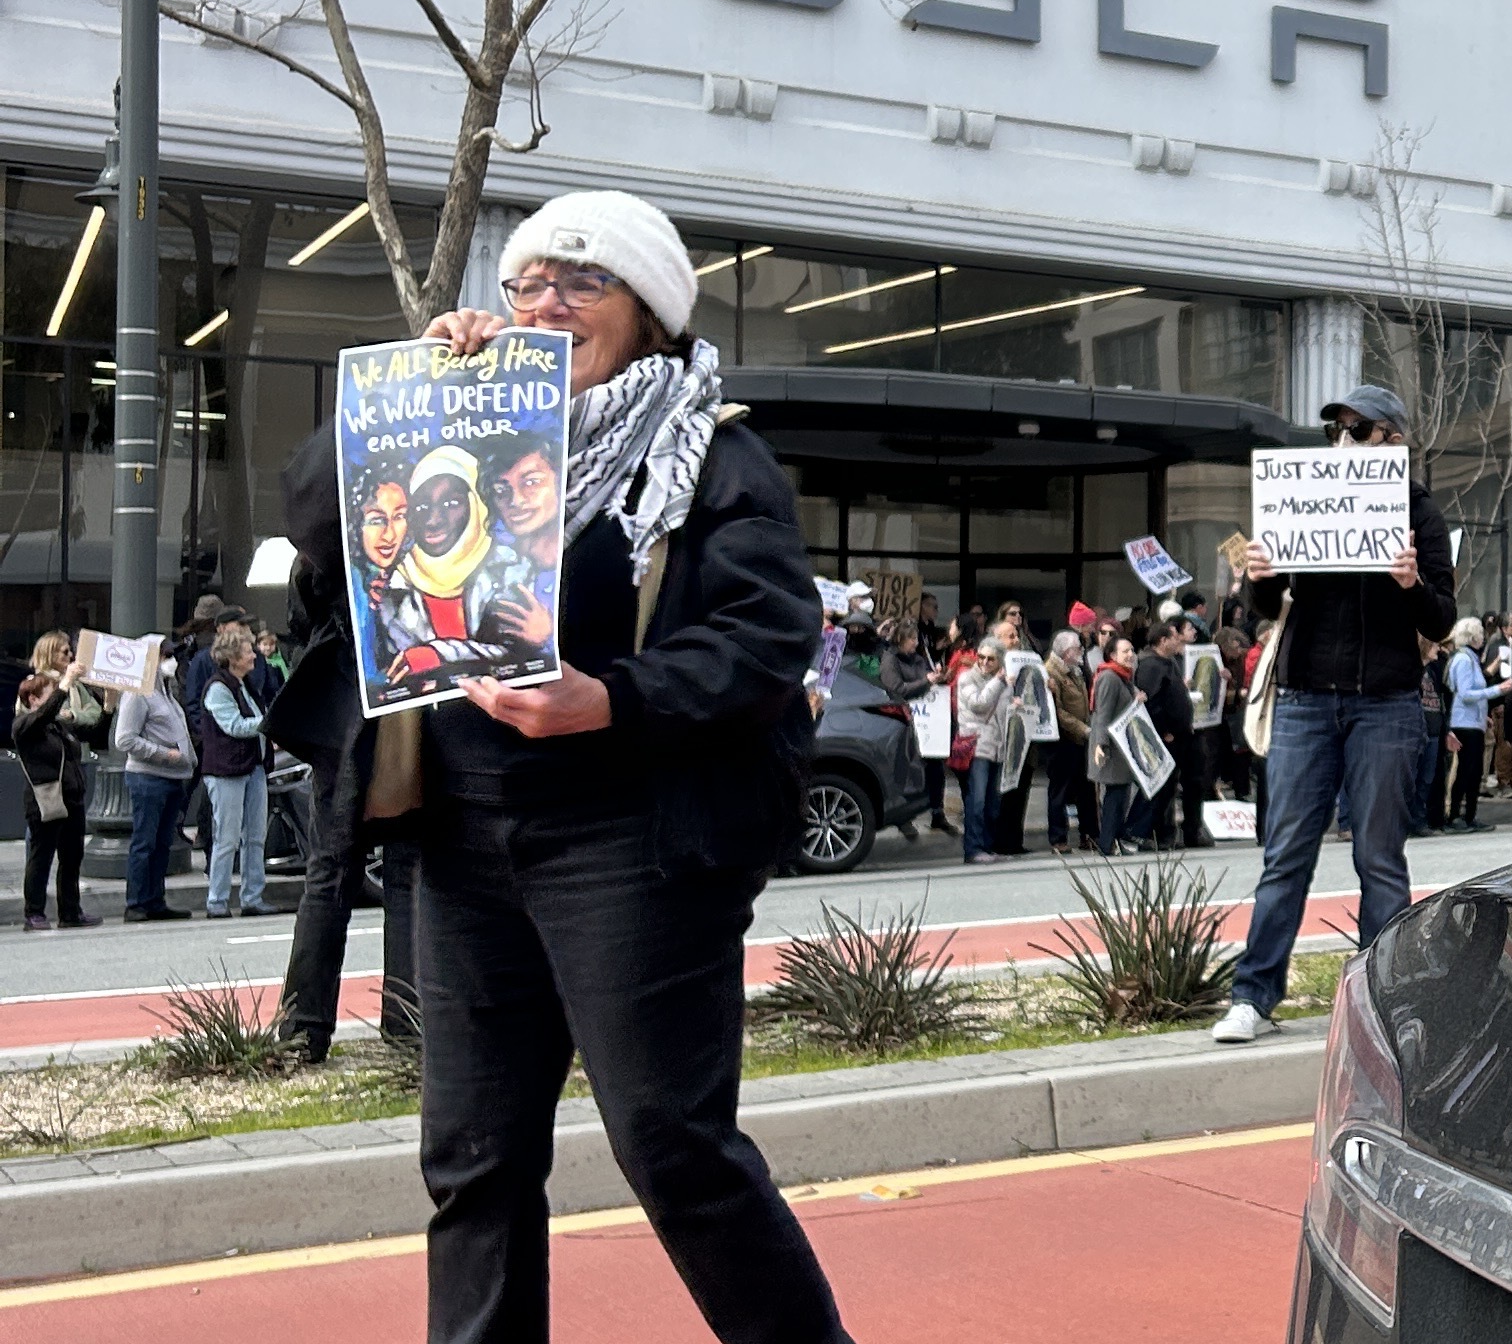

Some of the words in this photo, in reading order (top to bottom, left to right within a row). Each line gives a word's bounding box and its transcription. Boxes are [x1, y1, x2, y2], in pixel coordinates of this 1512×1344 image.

[352, 357, 382, 391] We
[386, 350, 426, 383] ALL
[344, 398, 378, 434] We
[1256, 458, 1305, 481] JUST
[1311, 461, 1341, 479] SAY
[1346, 458, 1406, 480] NEIN
[1279, 496, 1360, 515] MUSKRAT
[1262, 527, 1406, 563] SWASTICARS
[866, 570, 913, 594] STOP
[874, 593, 919, 616] USK
